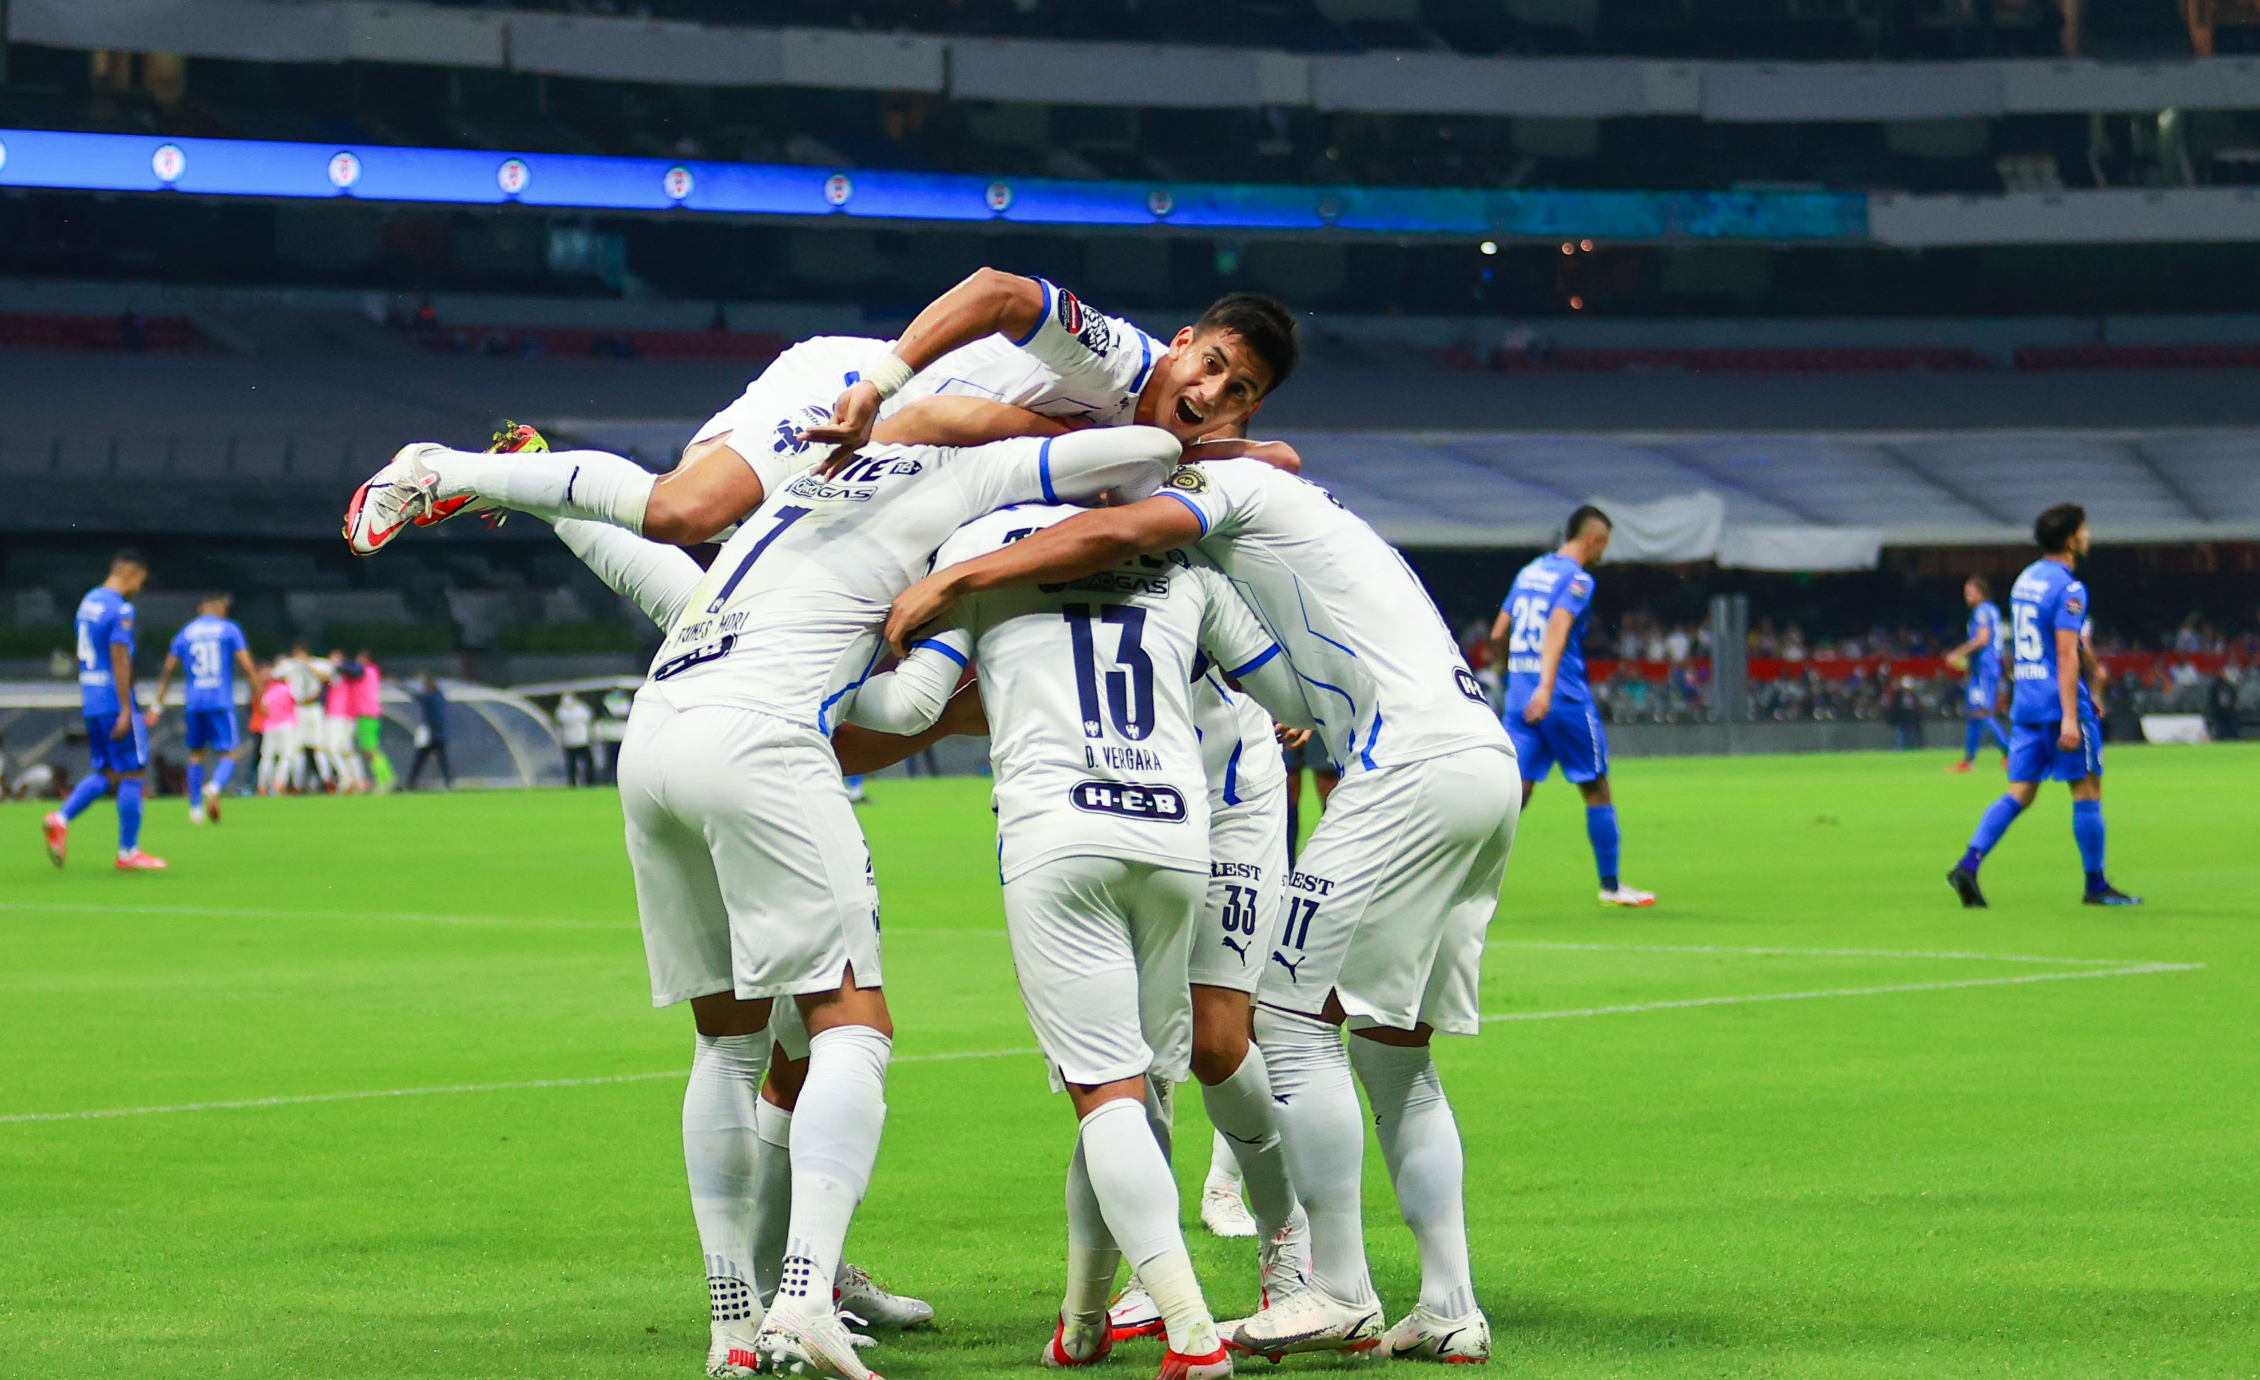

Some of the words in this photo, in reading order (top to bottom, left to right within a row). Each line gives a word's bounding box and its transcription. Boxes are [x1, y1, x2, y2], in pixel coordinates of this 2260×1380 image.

[715, 611, 750, 634] MORI
[1509, 595, 1550, 653] 25
[2011, 603, 2043, 661] 15
[189, 640, 222, 678] 31
[1062, 603, 1155, 741] 13
[1085, 745, 1099, 768] D.
[1103, 746, 1162, 770] VERGARA
[1084, 787, 1178, 814] H-E-B
[1221, 884, 1258, 936] 33
[1281, 896, 1321, 950] 17
